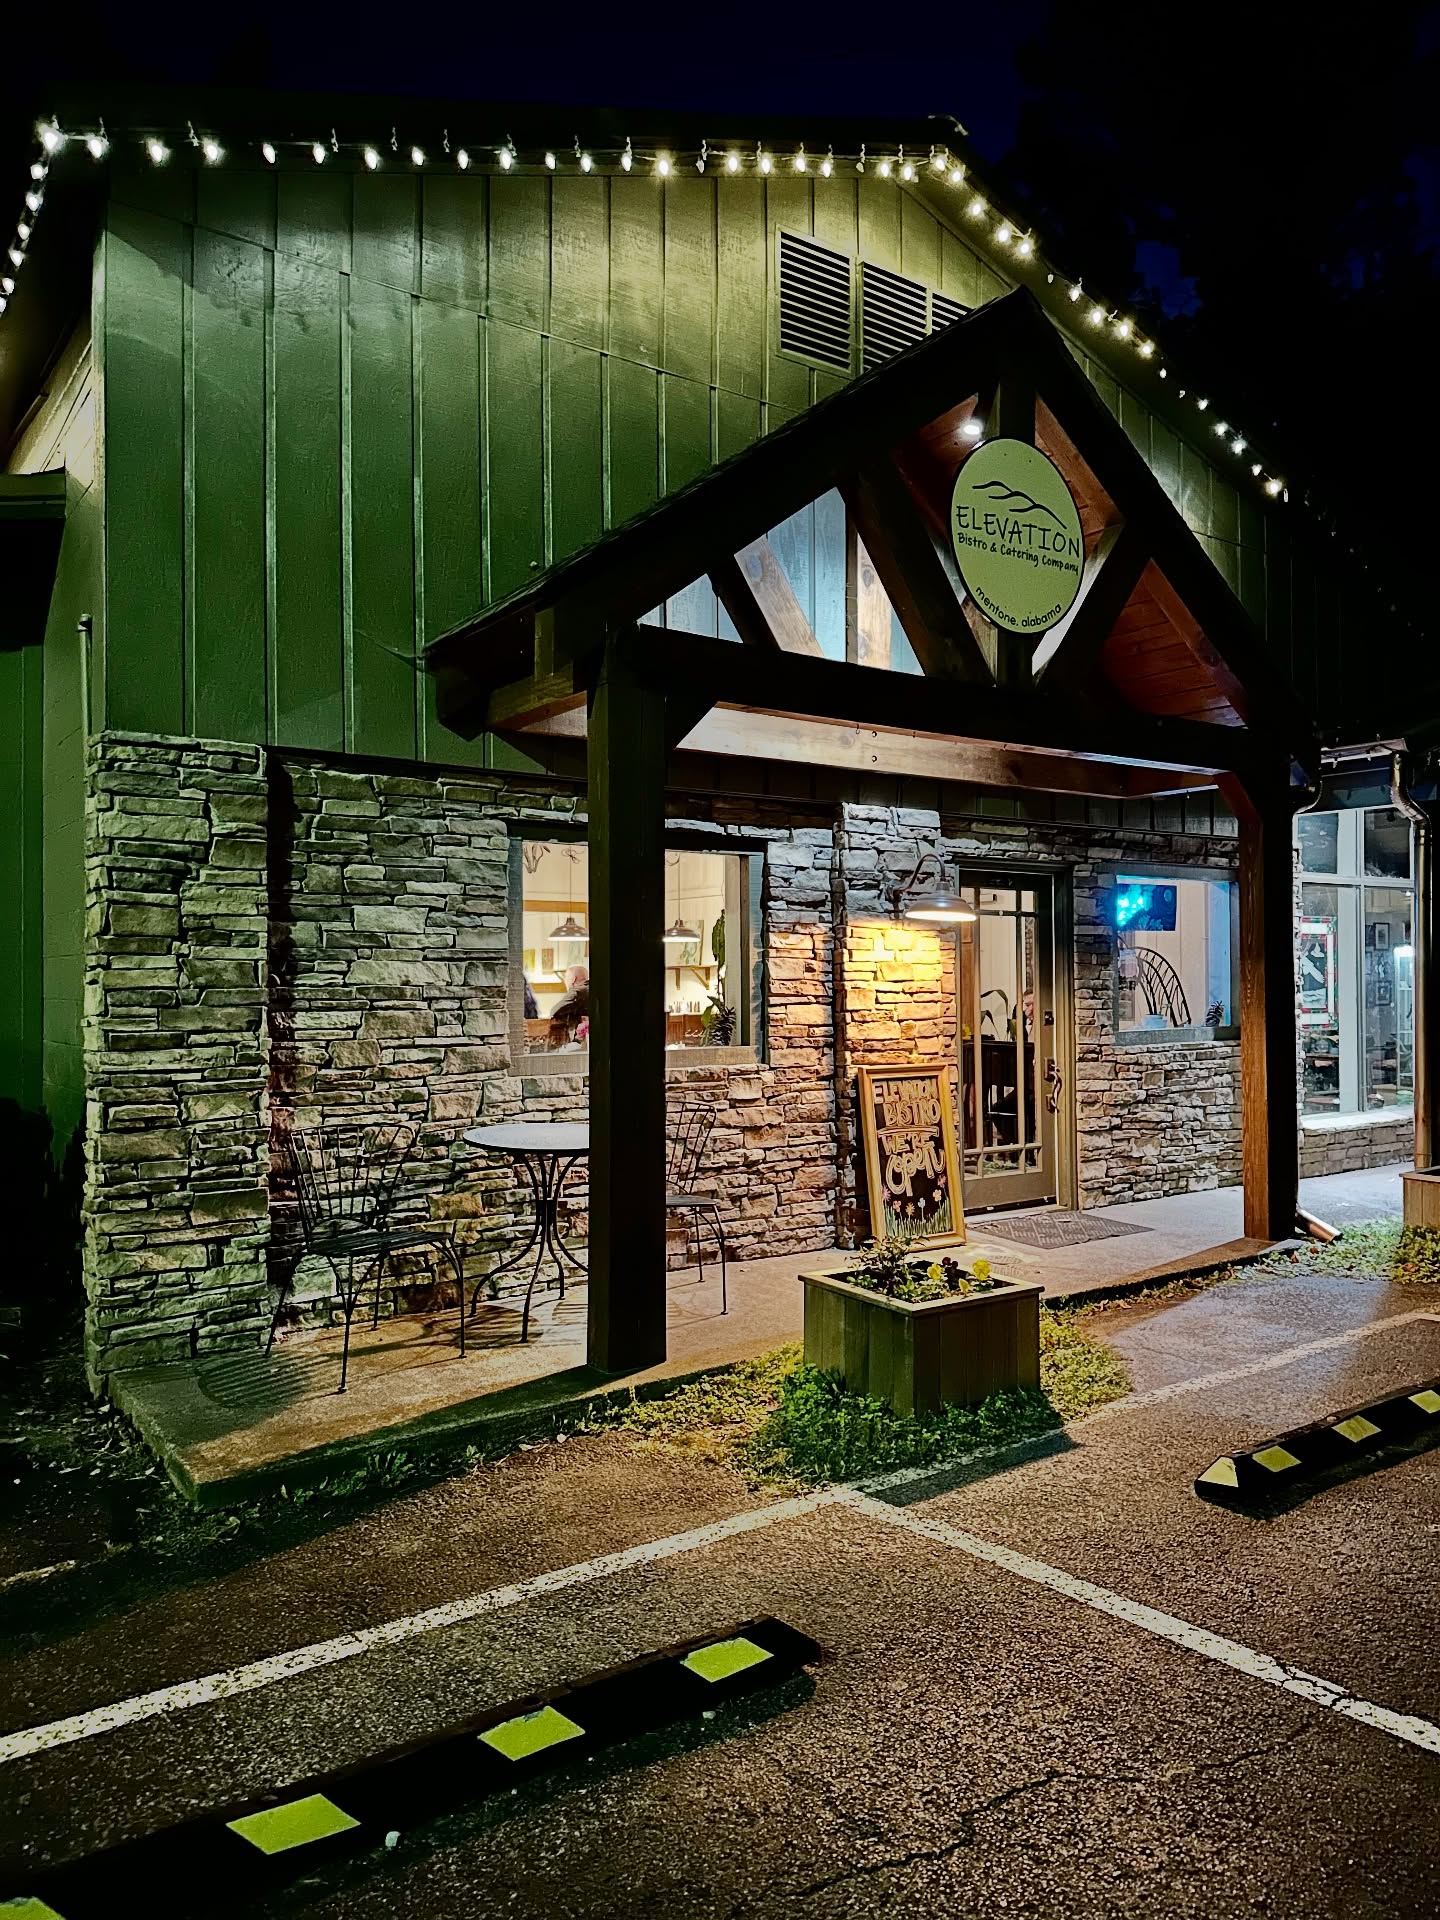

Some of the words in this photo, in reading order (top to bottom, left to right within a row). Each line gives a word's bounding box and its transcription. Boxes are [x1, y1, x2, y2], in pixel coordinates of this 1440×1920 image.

[956, 505, 1080, 558] ELEVATION
[957, 532, 988, 550] Bistro
[989, 542, 998, 552] &
[1000, 545, 1039, 568] Catering
[1042, 554, 1079, 576] Company
[1021, 603, 1062, 628] alabama
[872, 1079, 938, 1104] ELEVATION
[884, 1099, 941, 1126] BISTRO
[881, 1133, 932, 1155] WE'RE
